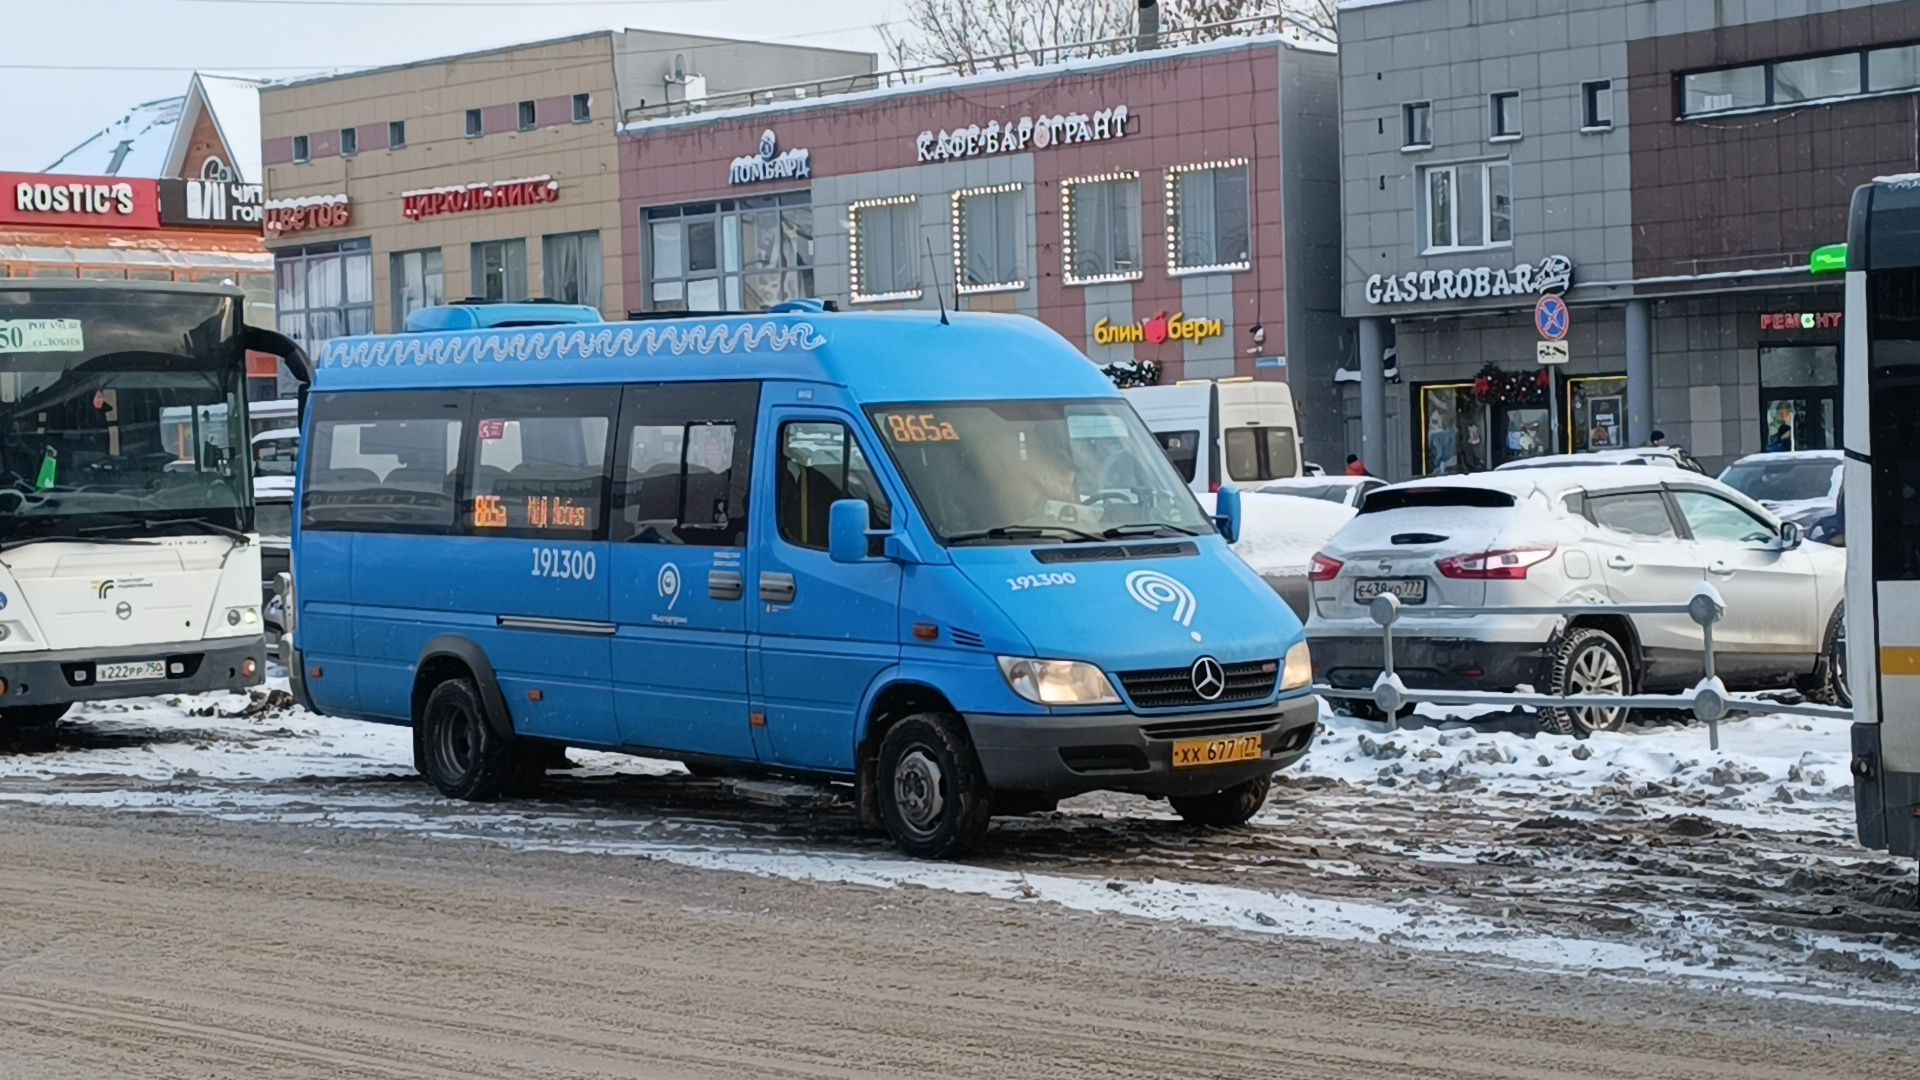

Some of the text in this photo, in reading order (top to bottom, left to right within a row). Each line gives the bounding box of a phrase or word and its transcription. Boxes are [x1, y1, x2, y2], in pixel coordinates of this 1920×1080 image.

[729, 149, 810, 185] ЛОМБАРД
[17, 182, 134, 214] ROSTIC'S
[264, 202, 349, 239] ЦВЕТОВ
[1365, 264, 1536, 304] GASTROBAR
[1093, 312, 1223, 345] блин бери
[531, 547, 597, 580] 191300
[1006, 572, 1077, 591] 191300
[1207, 740, 1236, 761] 677
[1244, 736, 1257, 751] 77
